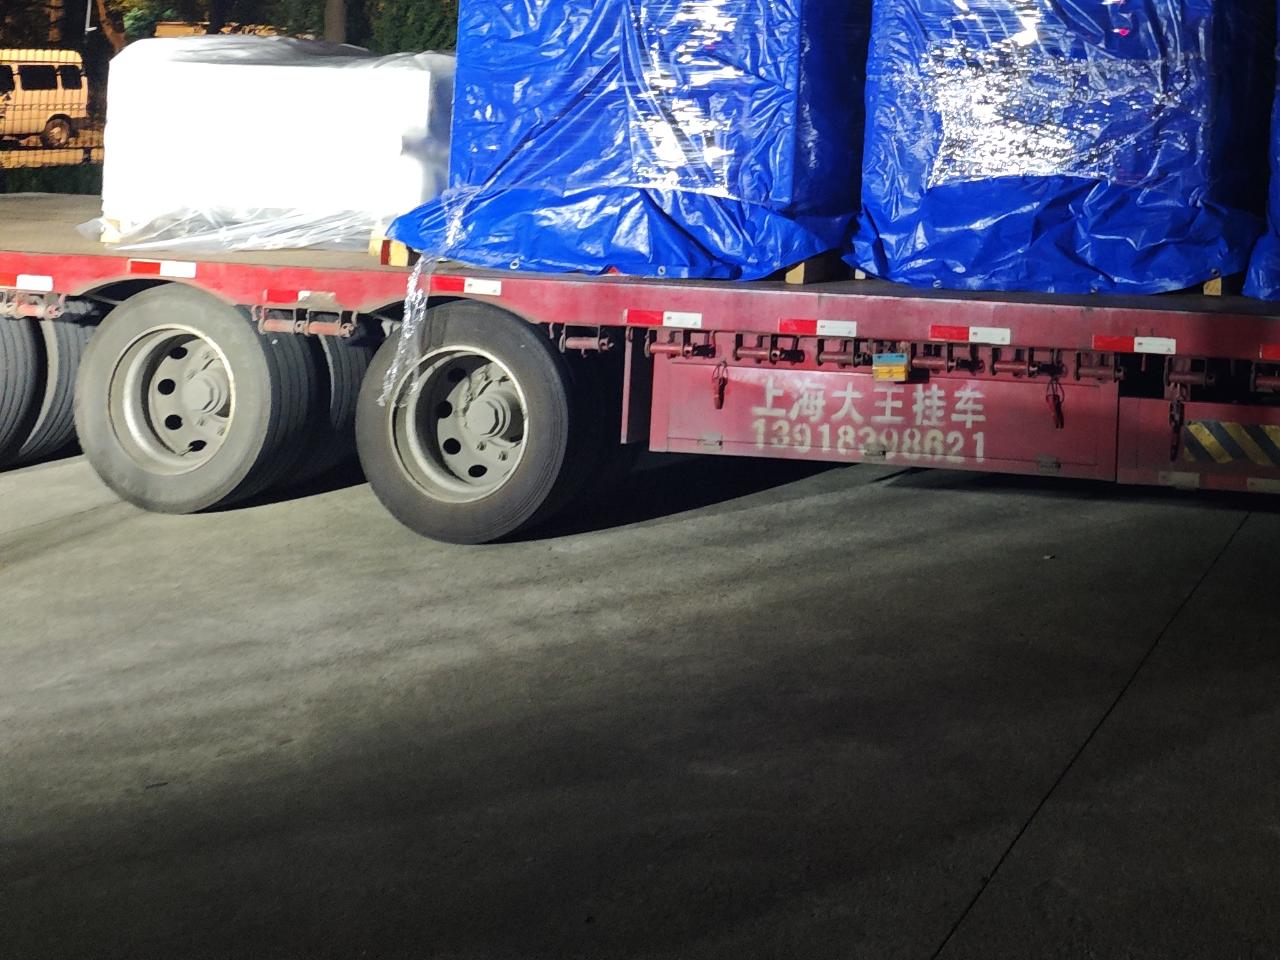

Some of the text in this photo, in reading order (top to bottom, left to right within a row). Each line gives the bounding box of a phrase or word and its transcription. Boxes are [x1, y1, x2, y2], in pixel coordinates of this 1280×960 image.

[752, 377, 986, 428] 上海大王挂车
